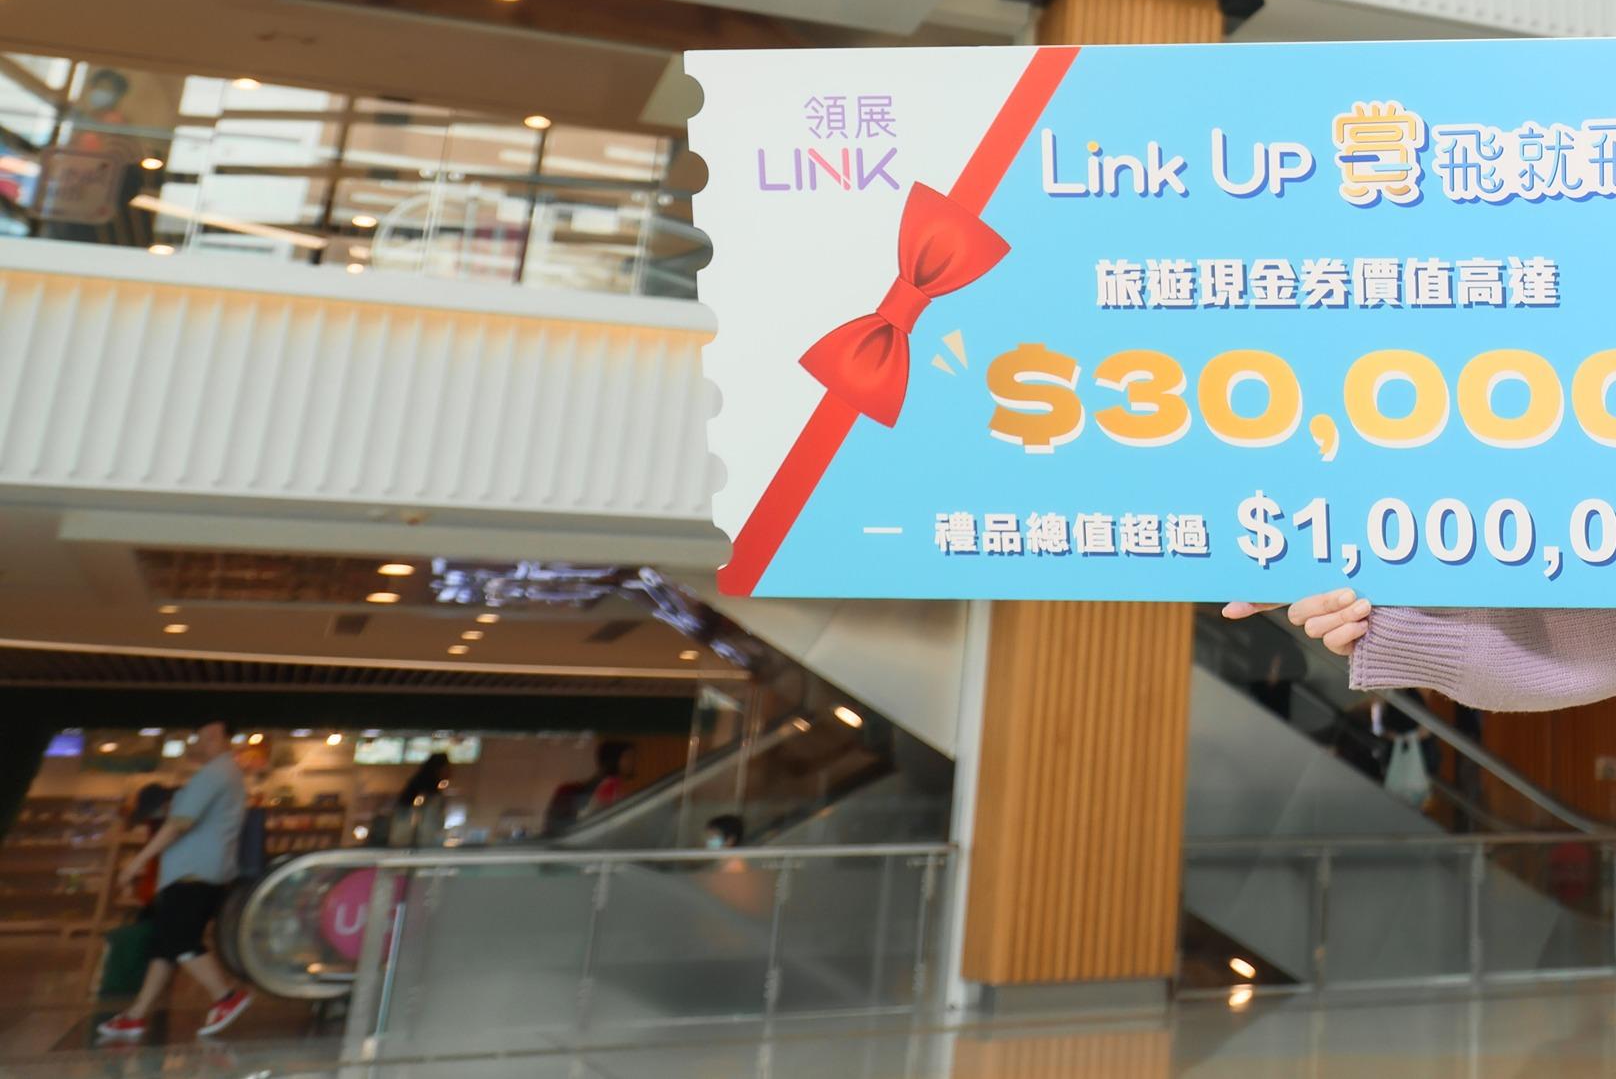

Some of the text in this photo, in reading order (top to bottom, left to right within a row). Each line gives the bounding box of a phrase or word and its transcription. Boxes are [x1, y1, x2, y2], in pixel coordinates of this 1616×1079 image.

[804, 95, 897, 139] 領展
[758, 148, 900, 191] LINK
[1040, 127, 1190, 198] Link
[1095, 256, 1561, 310] 旅遊現金券價值高達
[934, 512, 1211, 558] 禮品總值超過
